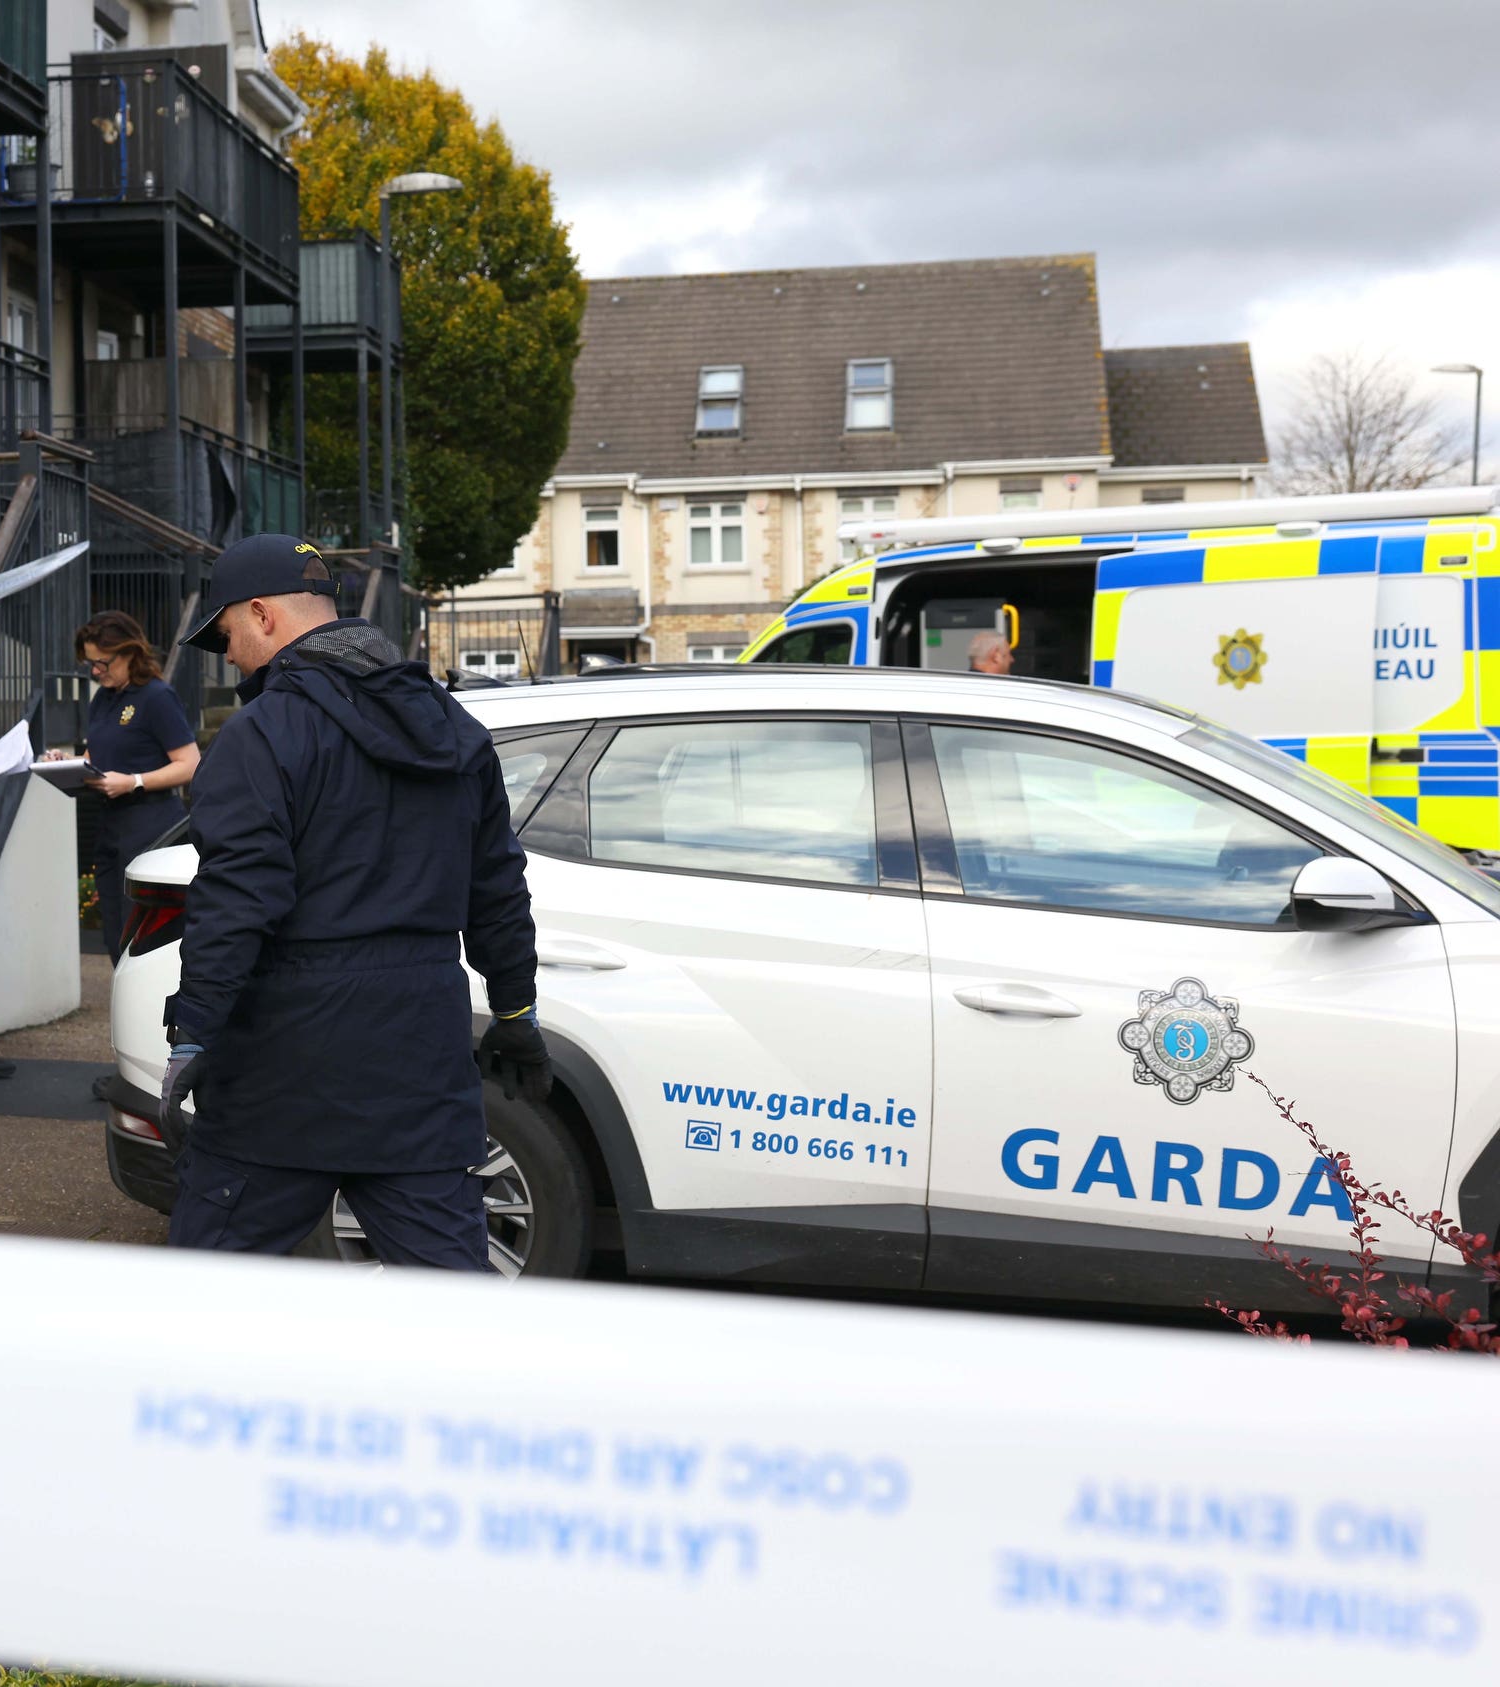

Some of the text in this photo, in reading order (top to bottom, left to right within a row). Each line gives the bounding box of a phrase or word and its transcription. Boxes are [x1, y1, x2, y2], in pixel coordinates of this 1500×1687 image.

[1373, 621, 1438, 649] IÚIL
[1375, 658, 1435, 681] EAU
[662, 1082, 917, 1128] www.garda.ie
[729, 1129, 909, 1168] 1 800 666 111
[1000, 1127, 1355, 1223] GARDA
[132, 1392, 911, 1516] COSC AR DHUL ISTEACH
[268, 1478, 760, 1582] LÁTHAIR COIRE
[1066, 1483, 1426, 1564] NO ENTRY
[996, 1548, 1480, 1656] CRIME SCENE
